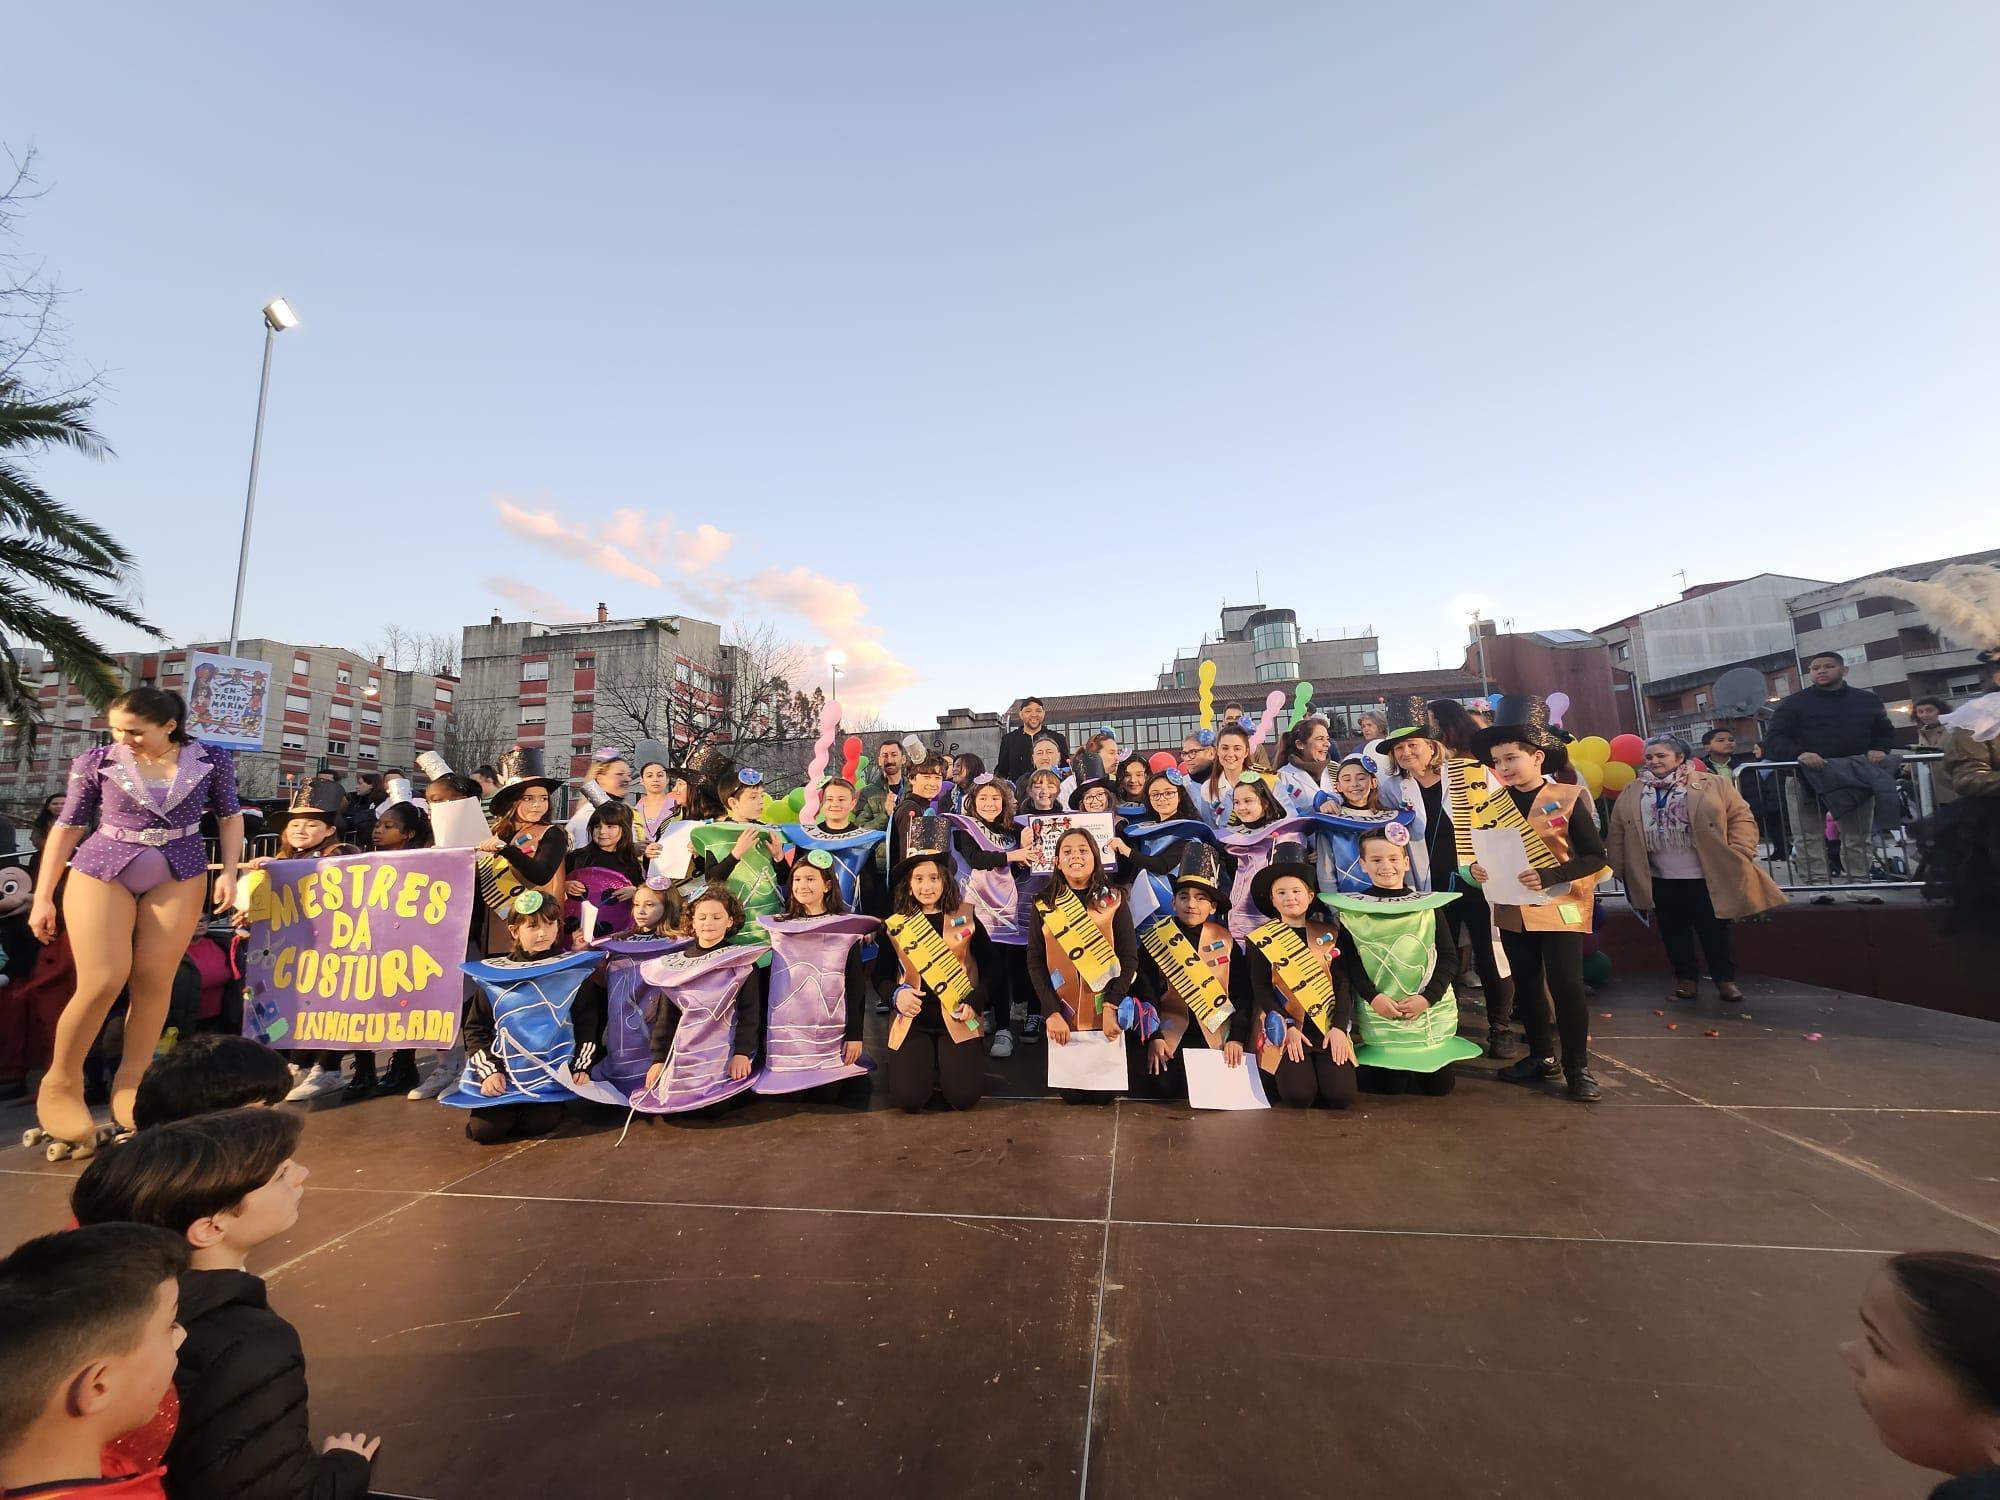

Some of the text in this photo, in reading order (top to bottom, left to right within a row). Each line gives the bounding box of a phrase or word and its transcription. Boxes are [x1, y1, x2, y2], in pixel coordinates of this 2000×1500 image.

[270, 864, 452, 931] MESTRES
[331, 908, 372, 952] DA
[273, 944, 443, 1001] COSTURA
[293, 1009, 455, 1043] INMACULADA
